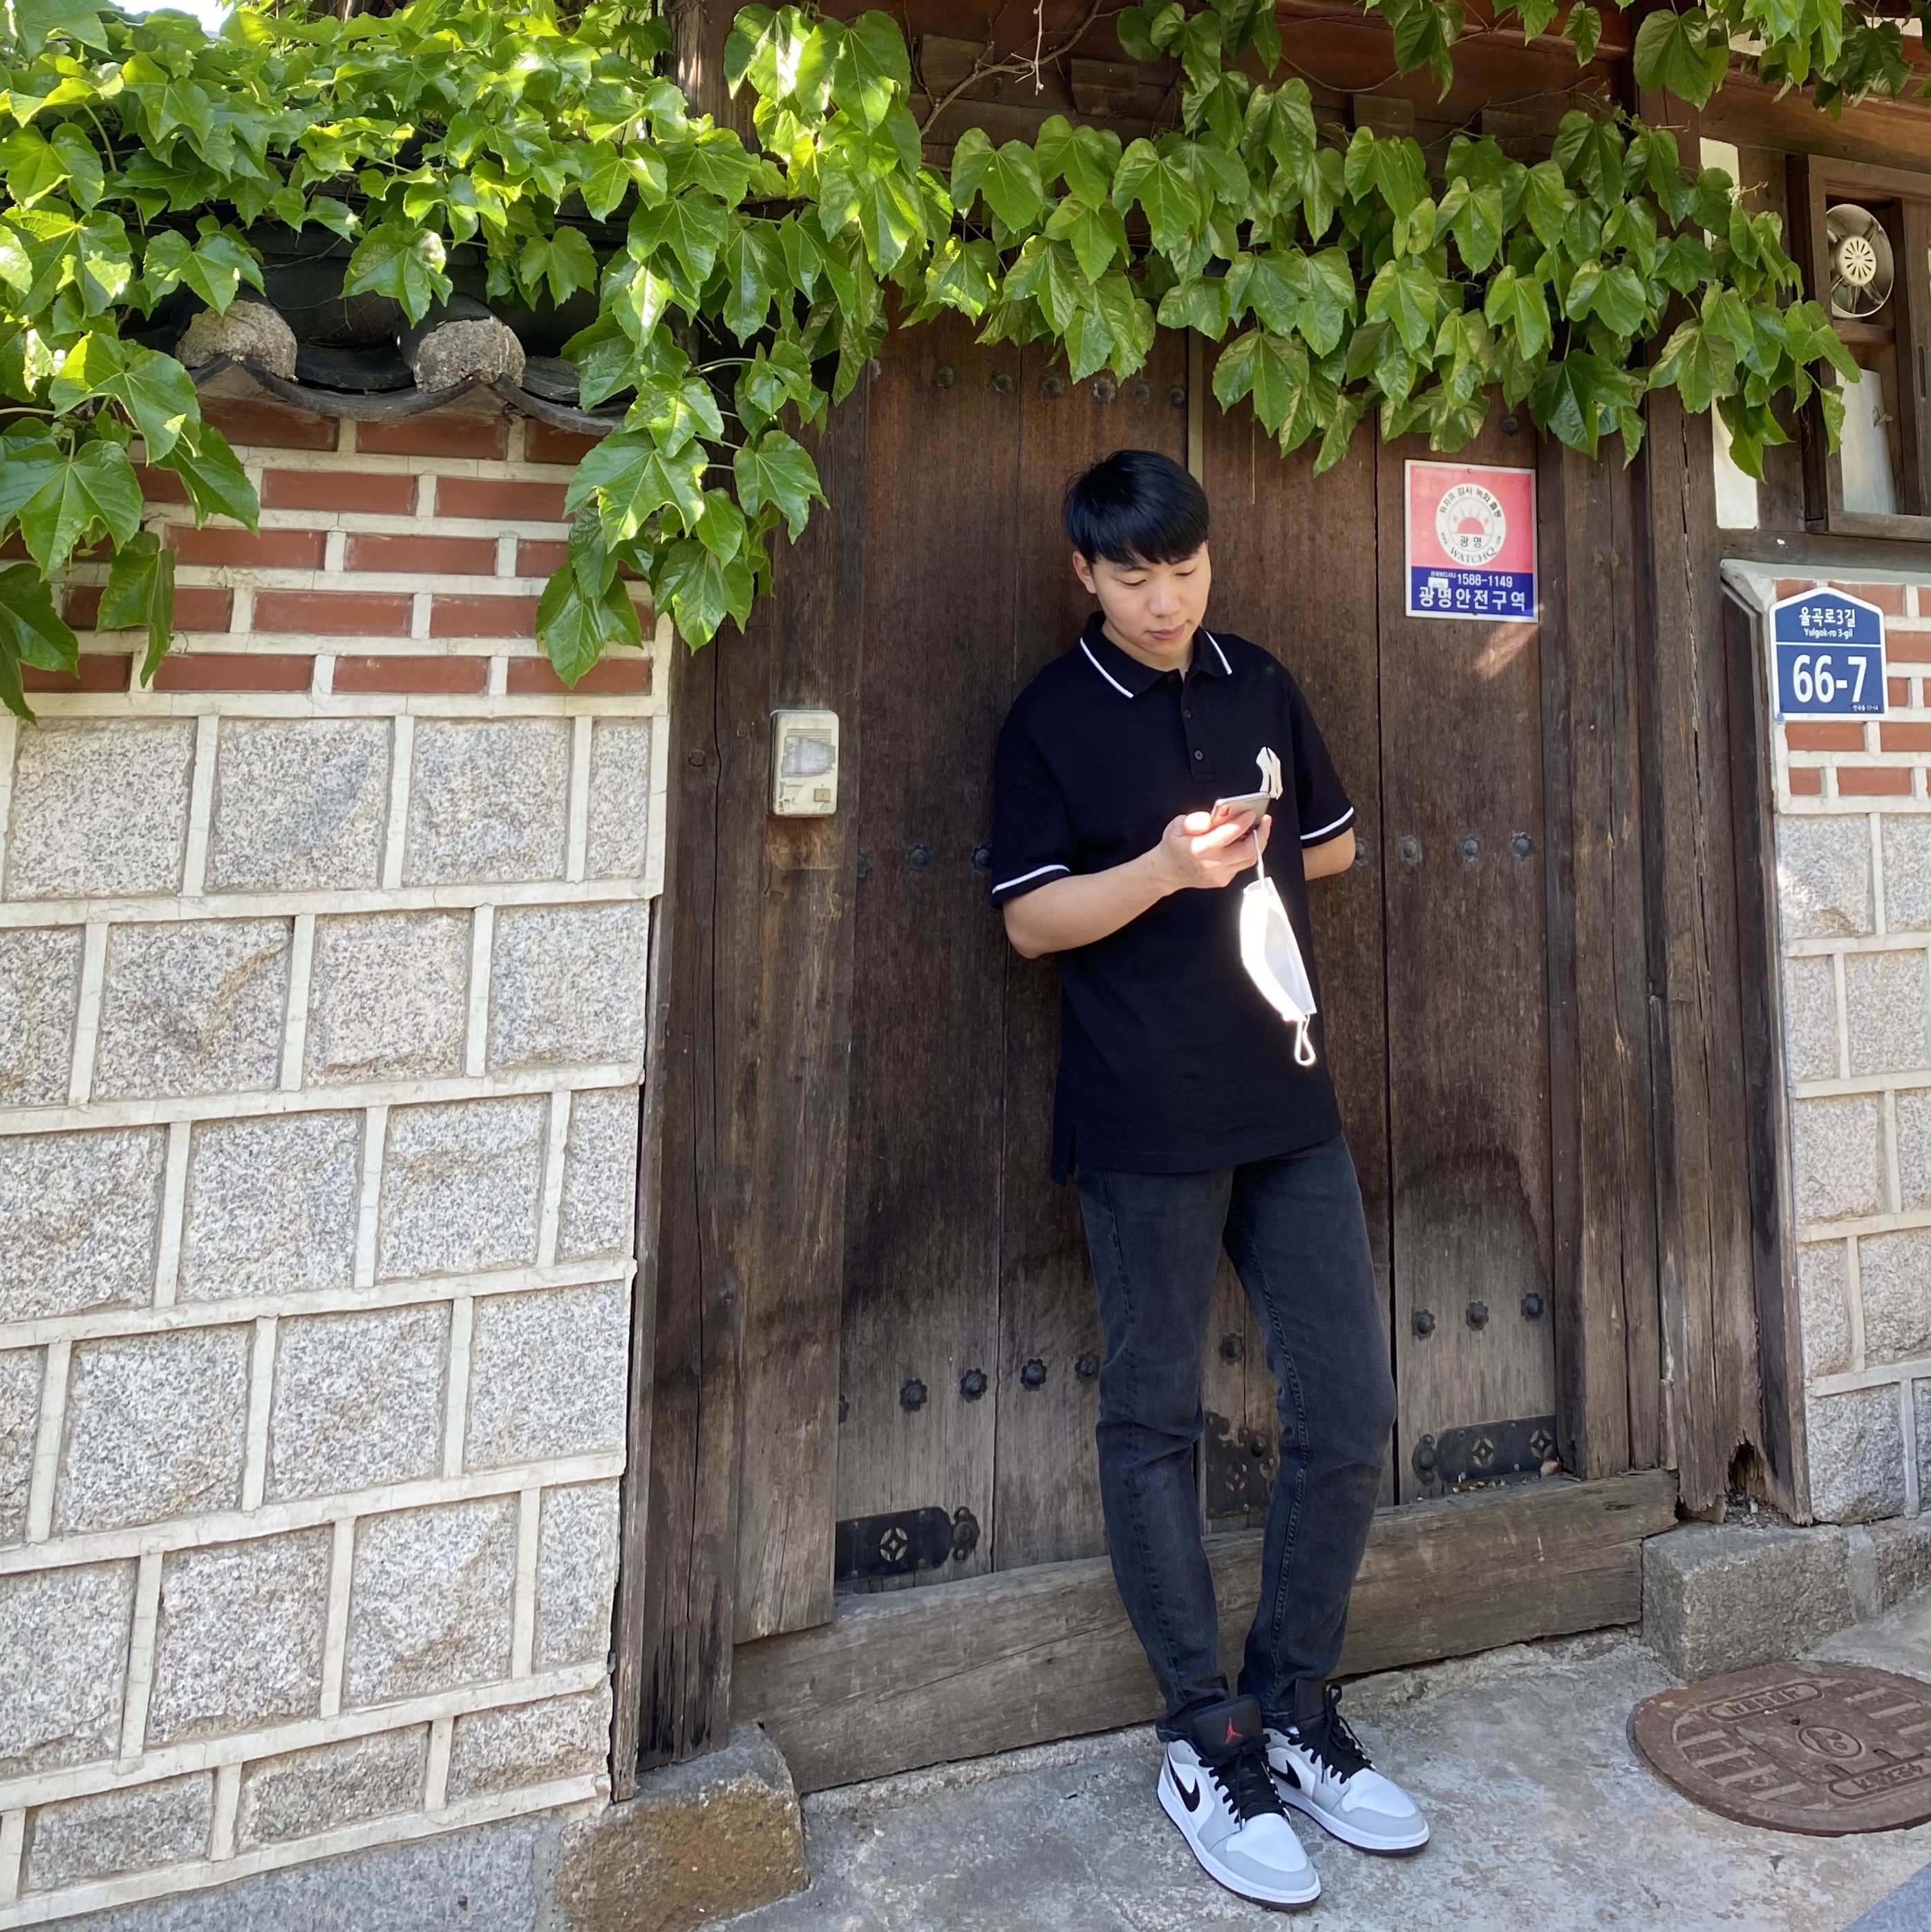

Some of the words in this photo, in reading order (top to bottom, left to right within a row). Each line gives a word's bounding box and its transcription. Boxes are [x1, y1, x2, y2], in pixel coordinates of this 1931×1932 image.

[1457, 486, 1472, 496] 감시
[1451, 547, 1497, 563] WATCHQ
[1457, 573, 1513, 588] 1588-1149
[1419, 586, 1525, 612] 광명안전구역
[1799, 607, 1855, 628] 율곡로3길
[1805, 628, 1837, 639] Yulgok-ro
[1838, 628, 1853, 639] 3-gil
[1793, 654, 1867, 703] 66-7
